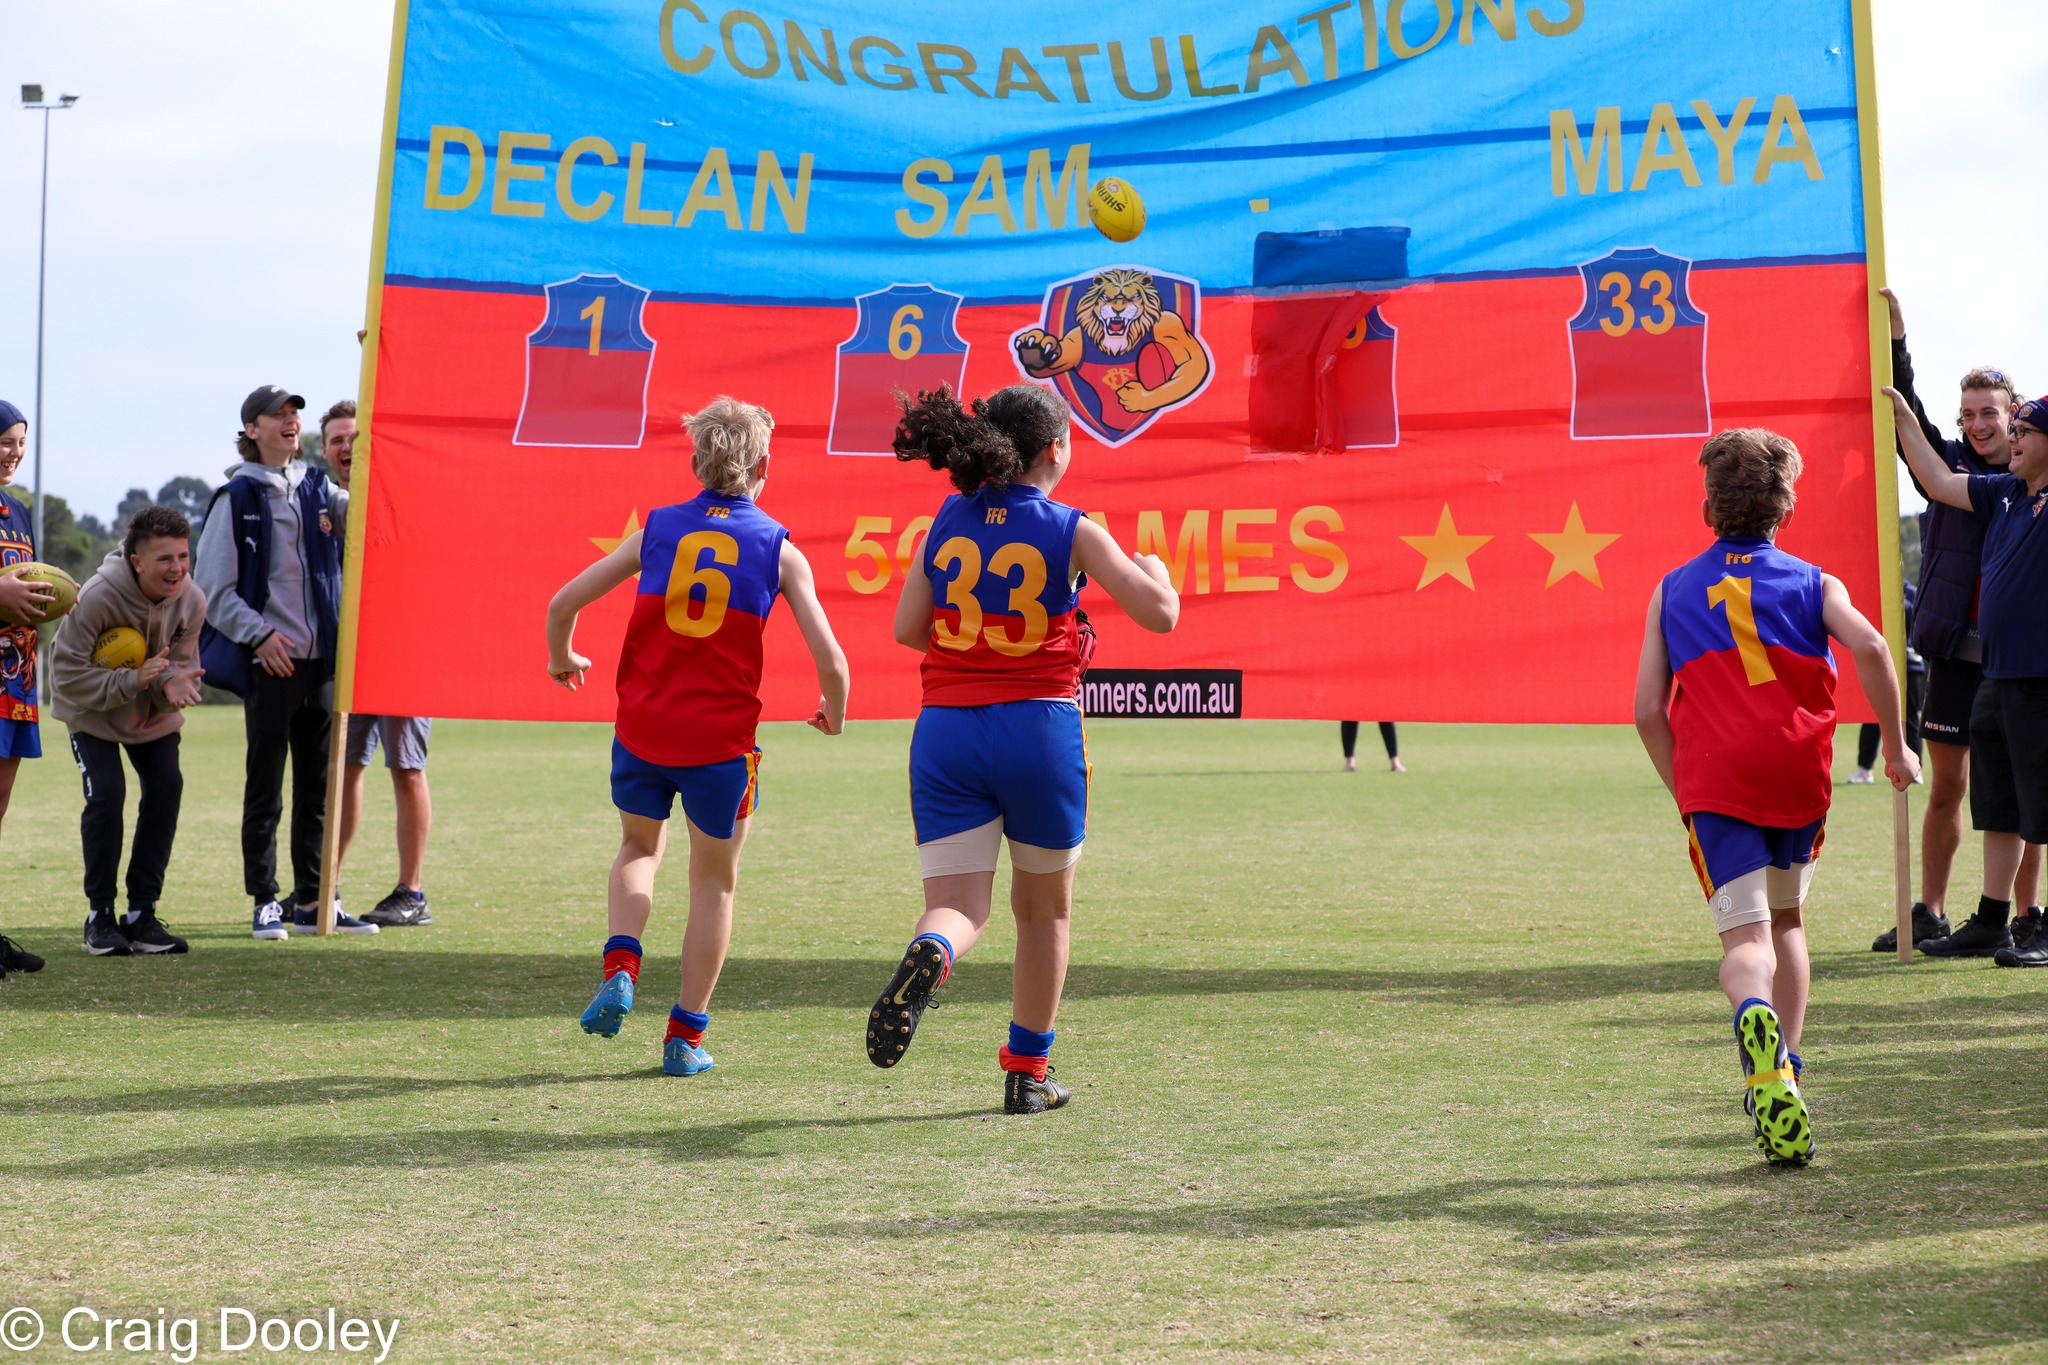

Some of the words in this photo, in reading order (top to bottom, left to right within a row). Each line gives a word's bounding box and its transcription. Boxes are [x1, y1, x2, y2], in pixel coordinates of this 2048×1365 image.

[423, 124, 815, 234] DECLAN
[895, 142, 1092, 238] SAM
[1548, 94, 1825, 197] MAYA
[579, 295, 605, 357] 1
[888, 303, 925, 360] 6
[1599, 269, 1677, 337] 33
[705, 506, 731, 519] FFC
[985, 507, 1008, 525] FFC
[664, 530, 740, 638] 6
[933, 535, 1048, 658] 33
[1707, 576, 1778, 687] 1
[1924, 721, 1959, 733] NISSAN
